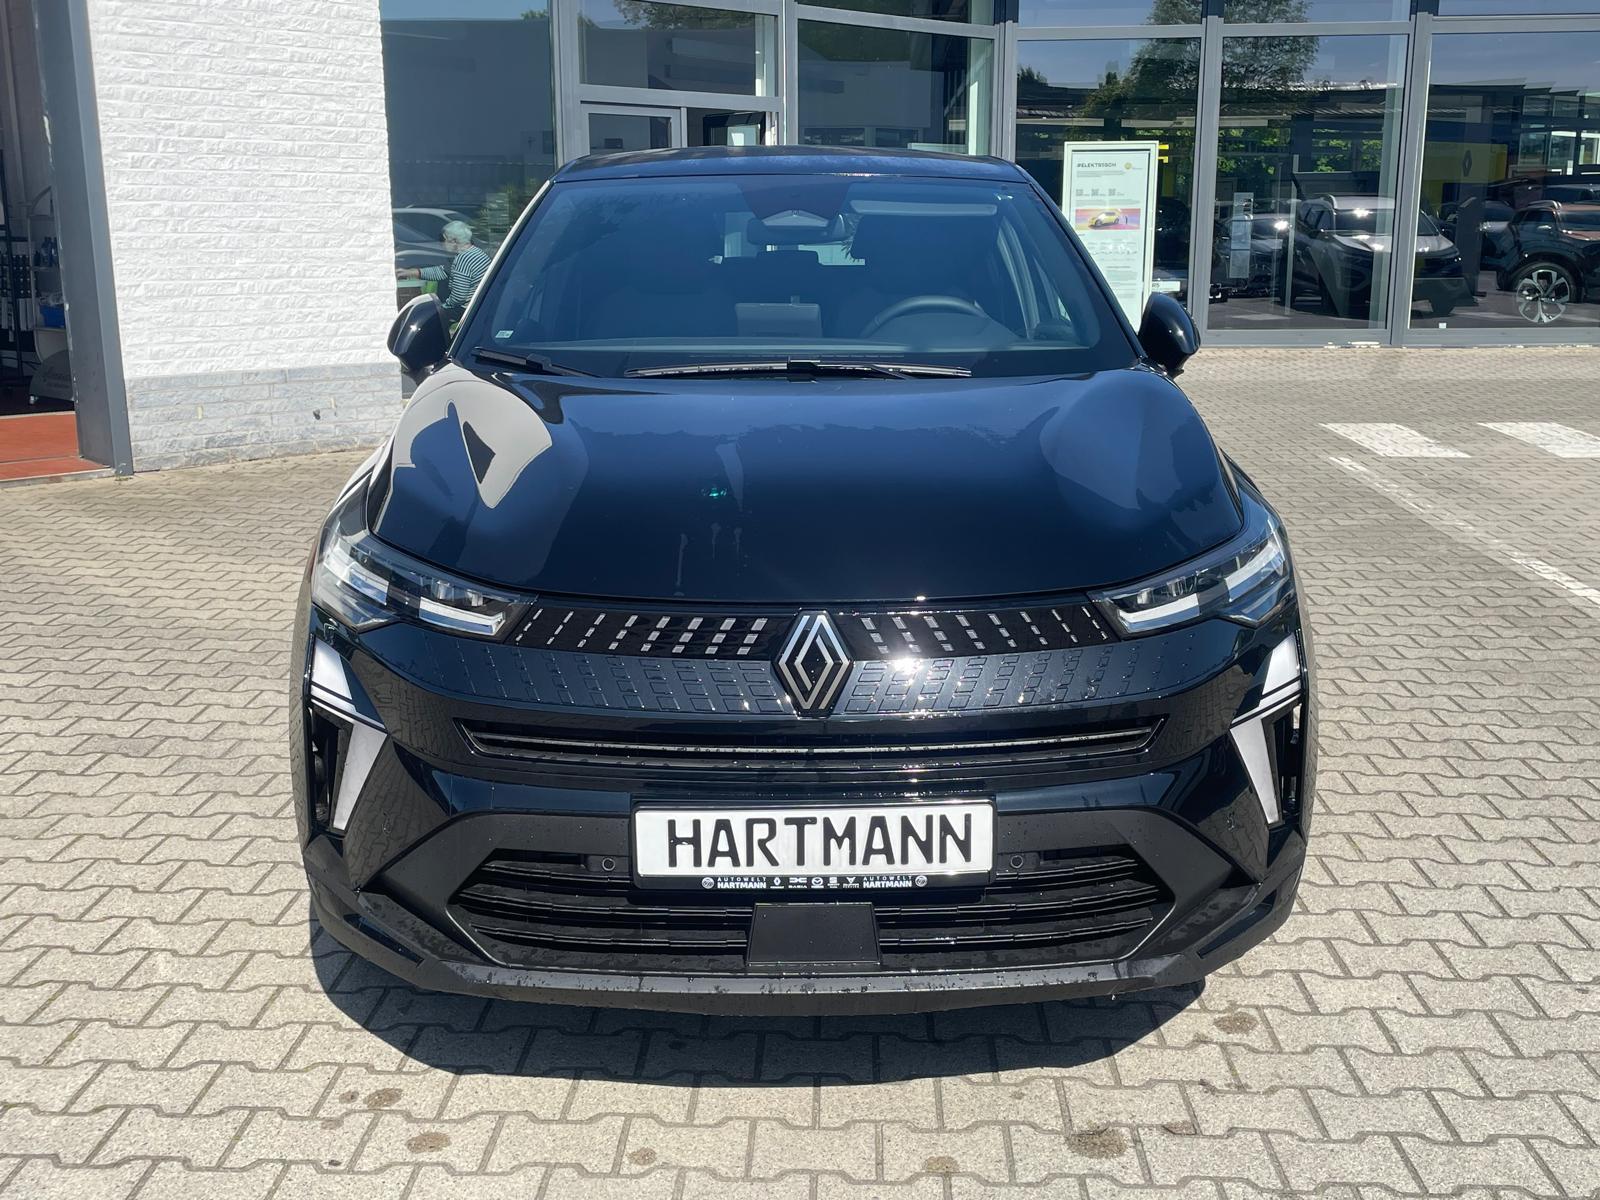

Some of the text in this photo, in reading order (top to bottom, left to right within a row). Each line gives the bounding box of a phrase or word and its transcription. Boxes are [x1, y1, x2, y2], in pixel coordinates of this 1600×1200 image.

[667, 813, 972, 868] HARTMANN
[717, 881, 767, 889] HARTMANN
[863, 880, 913, 889] HARTMANN
